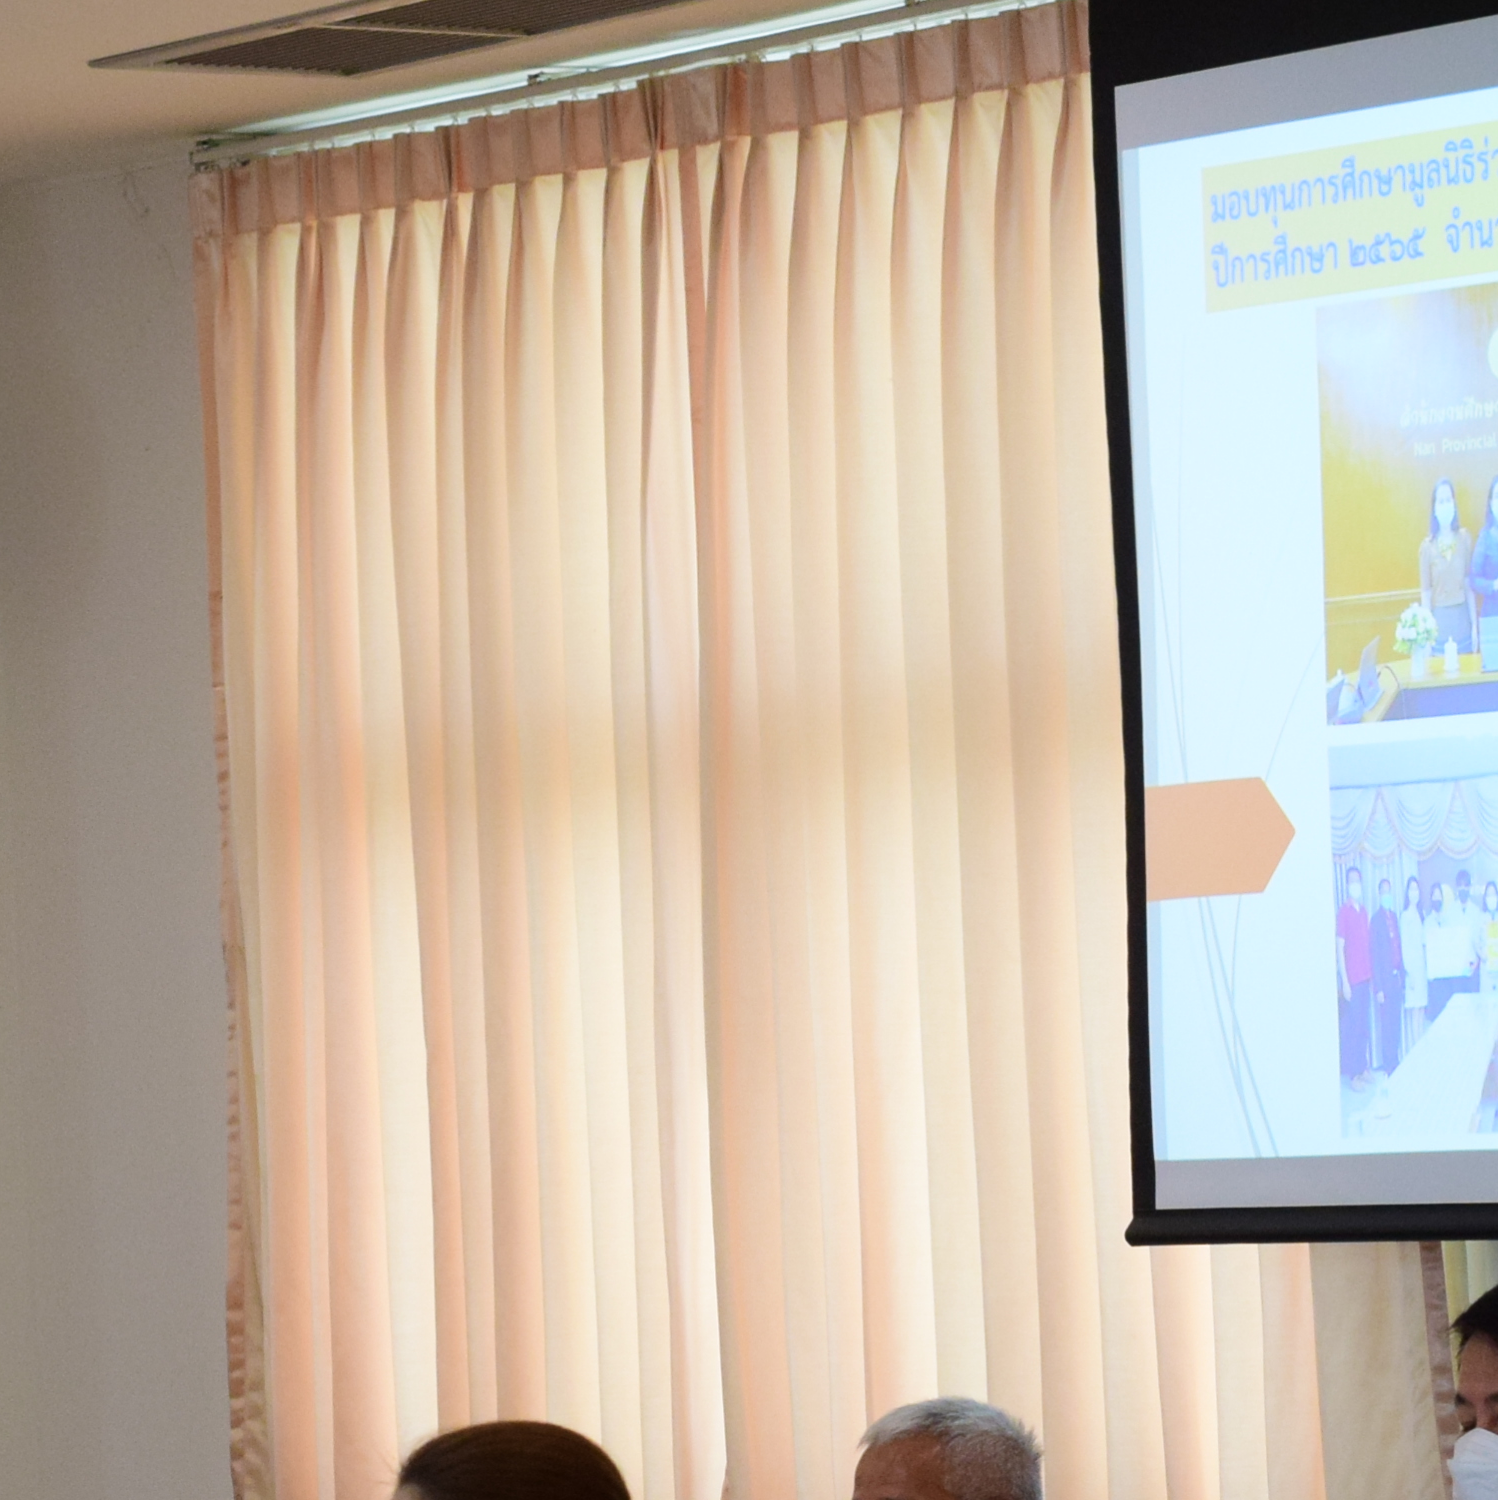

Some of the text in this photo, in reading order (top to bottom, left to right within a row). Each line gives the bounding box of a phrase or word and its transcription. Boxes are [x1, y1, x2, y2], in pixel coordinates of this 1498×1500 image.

[1212, 232, 1338, 288] ปีการศึกษา
[1348, 227, 1426, 267] ๒๕๖๕
[1441, 432, 1497, 454] Provincial
